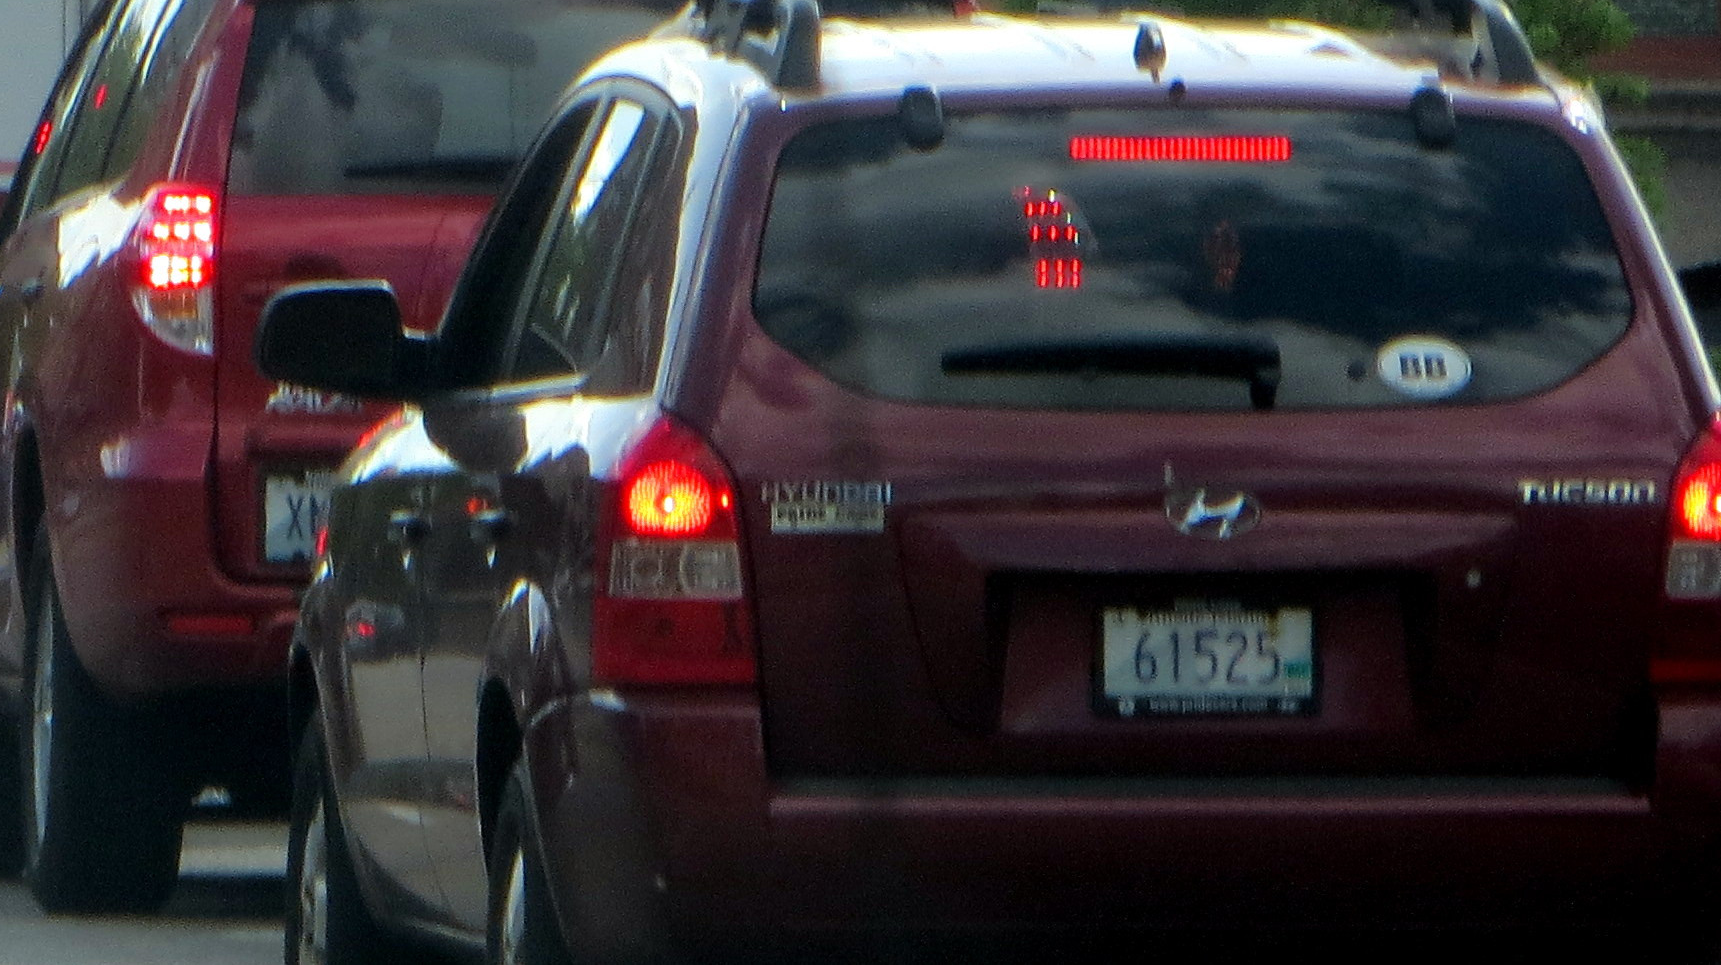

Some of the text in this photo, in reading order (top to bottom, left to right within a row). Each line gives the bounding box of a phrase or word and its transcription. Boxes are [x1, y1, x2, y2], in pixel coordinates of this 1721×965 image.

[761, 480, 892, 505] HYUNDAI
[1519, 478, 1656, 505] TUCSON
[1134, 629, 1281, 685] 61525
